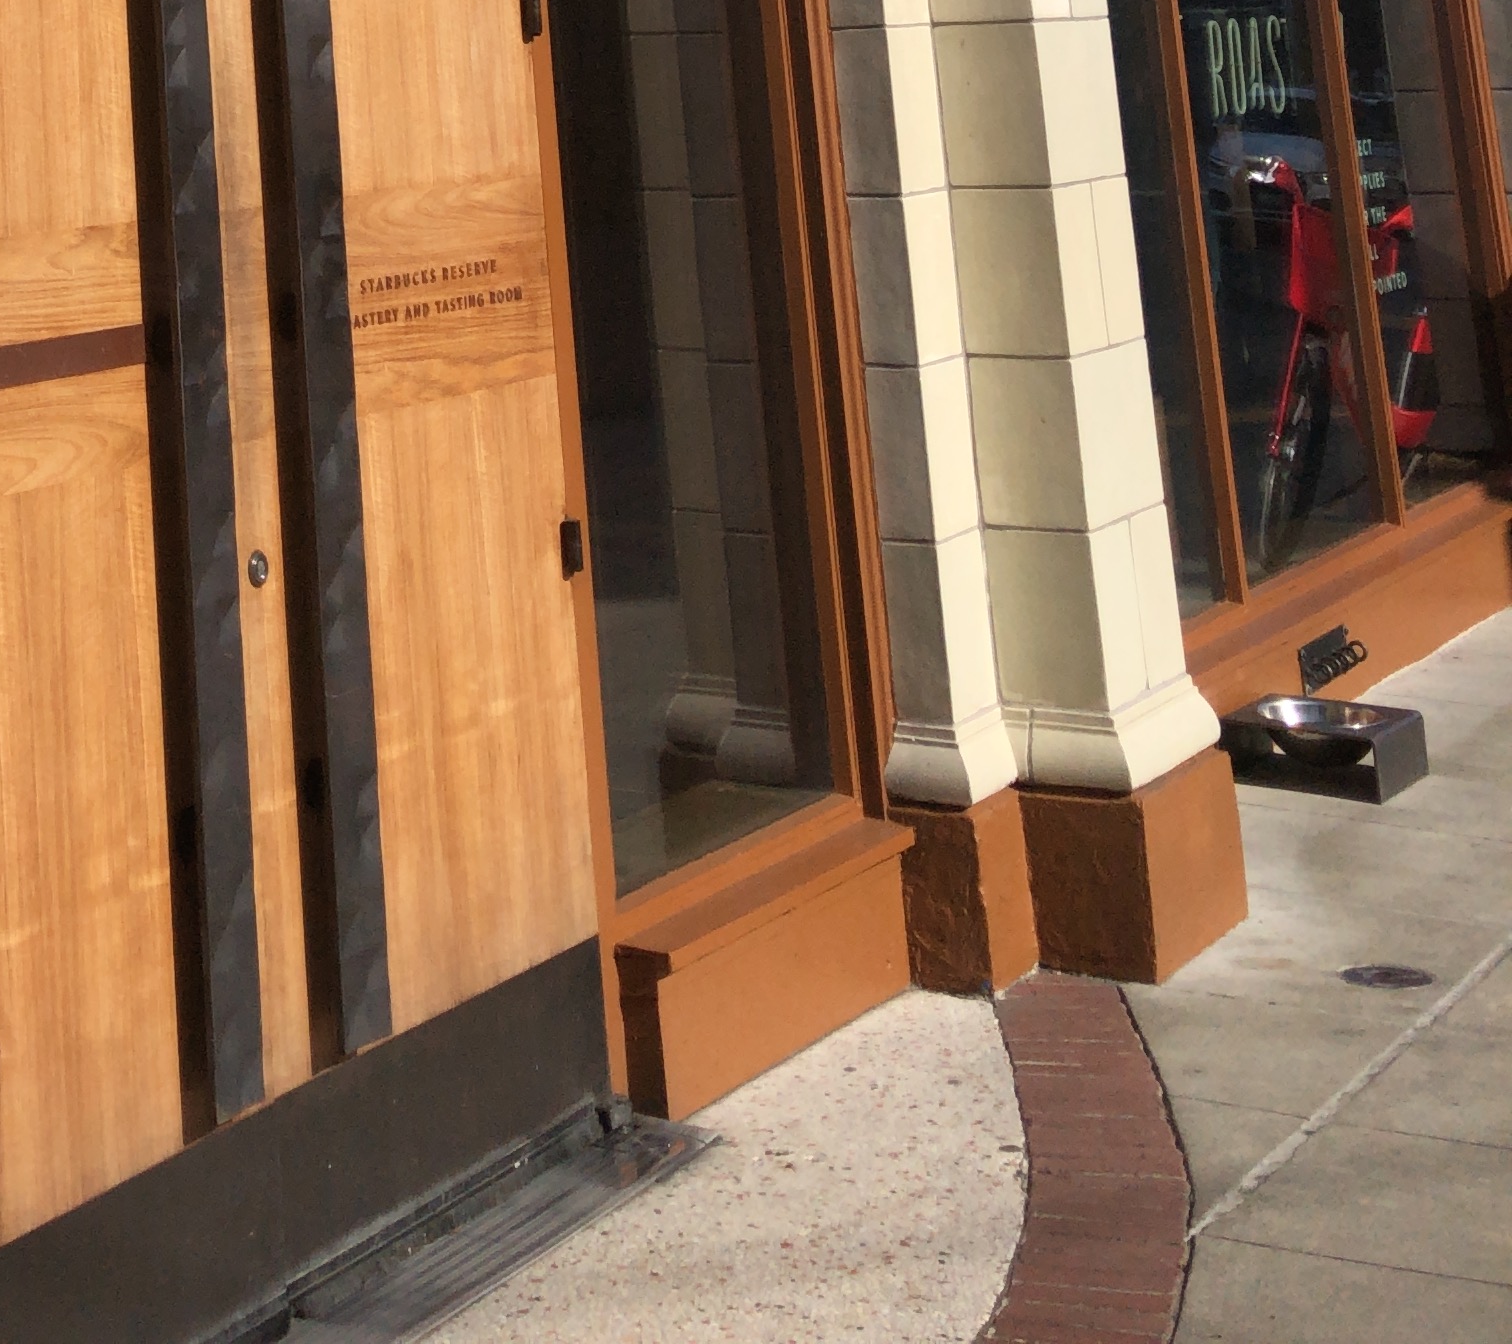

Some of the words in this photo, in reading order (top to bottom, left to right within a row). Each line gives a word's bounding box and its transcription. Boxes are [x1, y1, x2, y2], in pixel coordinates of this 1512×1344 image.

[360, 269, 437, 295] STARBUCKS
[442, 259, 497, 281] RESERVE
[353, 308, 399, 330] ASTERY
[404, 303, 429, 321] AND
[435, 292, 484, 314] TASTING
[489, 286, 523, 305] ROOM
